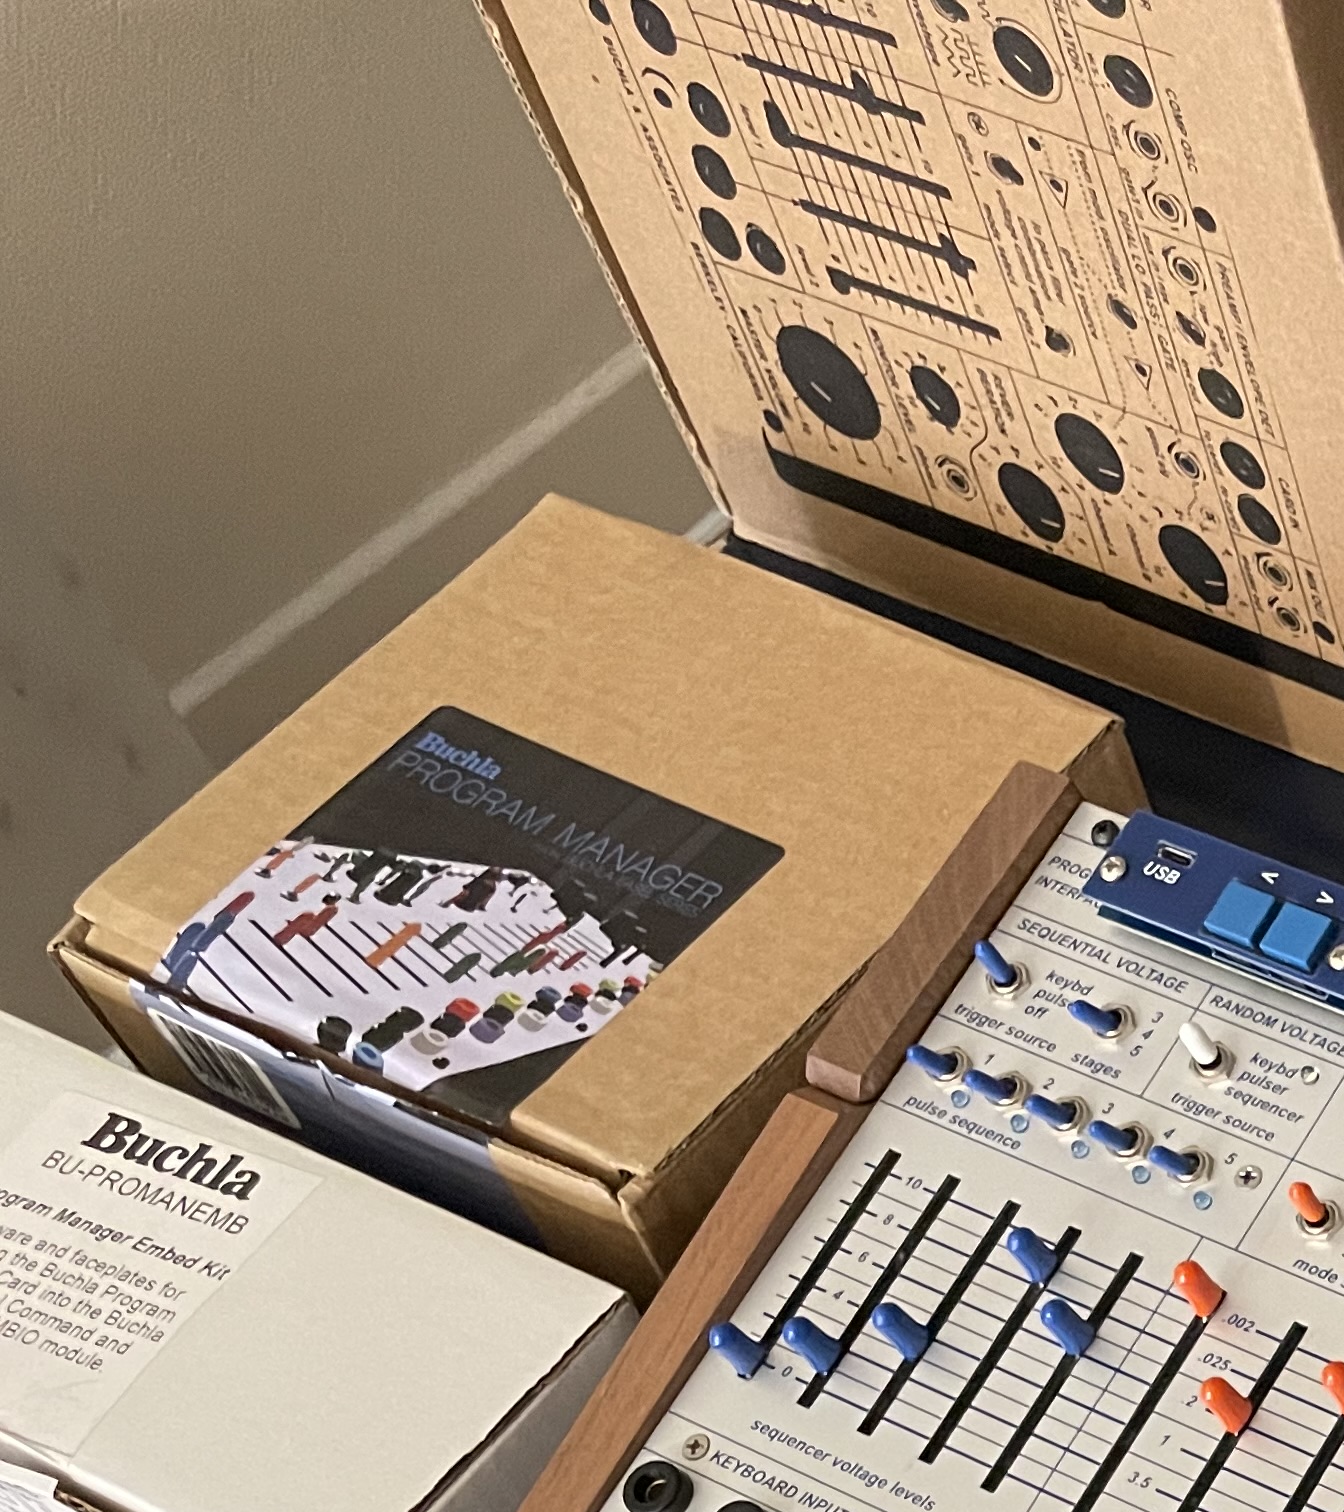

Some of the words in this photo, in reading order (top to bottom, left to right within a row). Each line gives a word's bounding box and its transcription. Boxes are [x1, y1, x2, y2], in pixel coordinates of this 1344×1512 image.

[414, 731, 501, 780] Buchla
[387, 751, 556, 835] PROGRAM
[556, 822, 724, 910] MANAGER
[1051, 855, 1091, 880] PROG
[1142, 861, 1181, 885] USB
[1017, 918, 1110, 964] SEQUENTIAL
[1115, 958, 1189, 994] VOLTAGE
[1045, 970, 1095, 997] keybd
[953, 1003, 1004, 1032] trigger
[1003, 1026, 1058, 1053] source
[1209, 994, 1279, 1033] RANDOM
[1070, 1051, 1122, 1080] stages
[903, 1095, 948, 1120] pulse
[948, 1112, 1022, 1151] sequence
[1223, 1084, 1305, 1124] sequencer
[81, 1111, 261, 1200] Buchla
[42, 1150, 249, 1235] BU-PROMANEMB
[0, 1190, 52, 1217] ogram
[52, 1207, 134, 1244] Manager
[132, 1236, 202, 1269] Embed
[197, 1260, 231, 1281] Kit
[10, 1253, 37, 1271] the
[40, 1263, 99, 1297] Buchla
[100, 1284, 177, 1323] Program
[35, 1239, 71, 1258] and
[69, 1249, 157, 1295] faceplates
[160, 1279, 187, 1302] for
[0, 1270, 40, 1295] Card
[39, 1285, 70, 1307] into
[73, 1300, 102, 1320] the
[103, 1310, 165, 1343] Buchla
[6, 1300, 98, 1344] Command
[95, 1334, 134, 1355] and
[39, 1339, 103, 1372] module.
[710, 1449, 800, 1500] KEYBOARD
[750, 1417, 831, 1463] sequencer
[830, 1454, 888, 1490] voltage
[888, 1483, 938, 1512] levels
